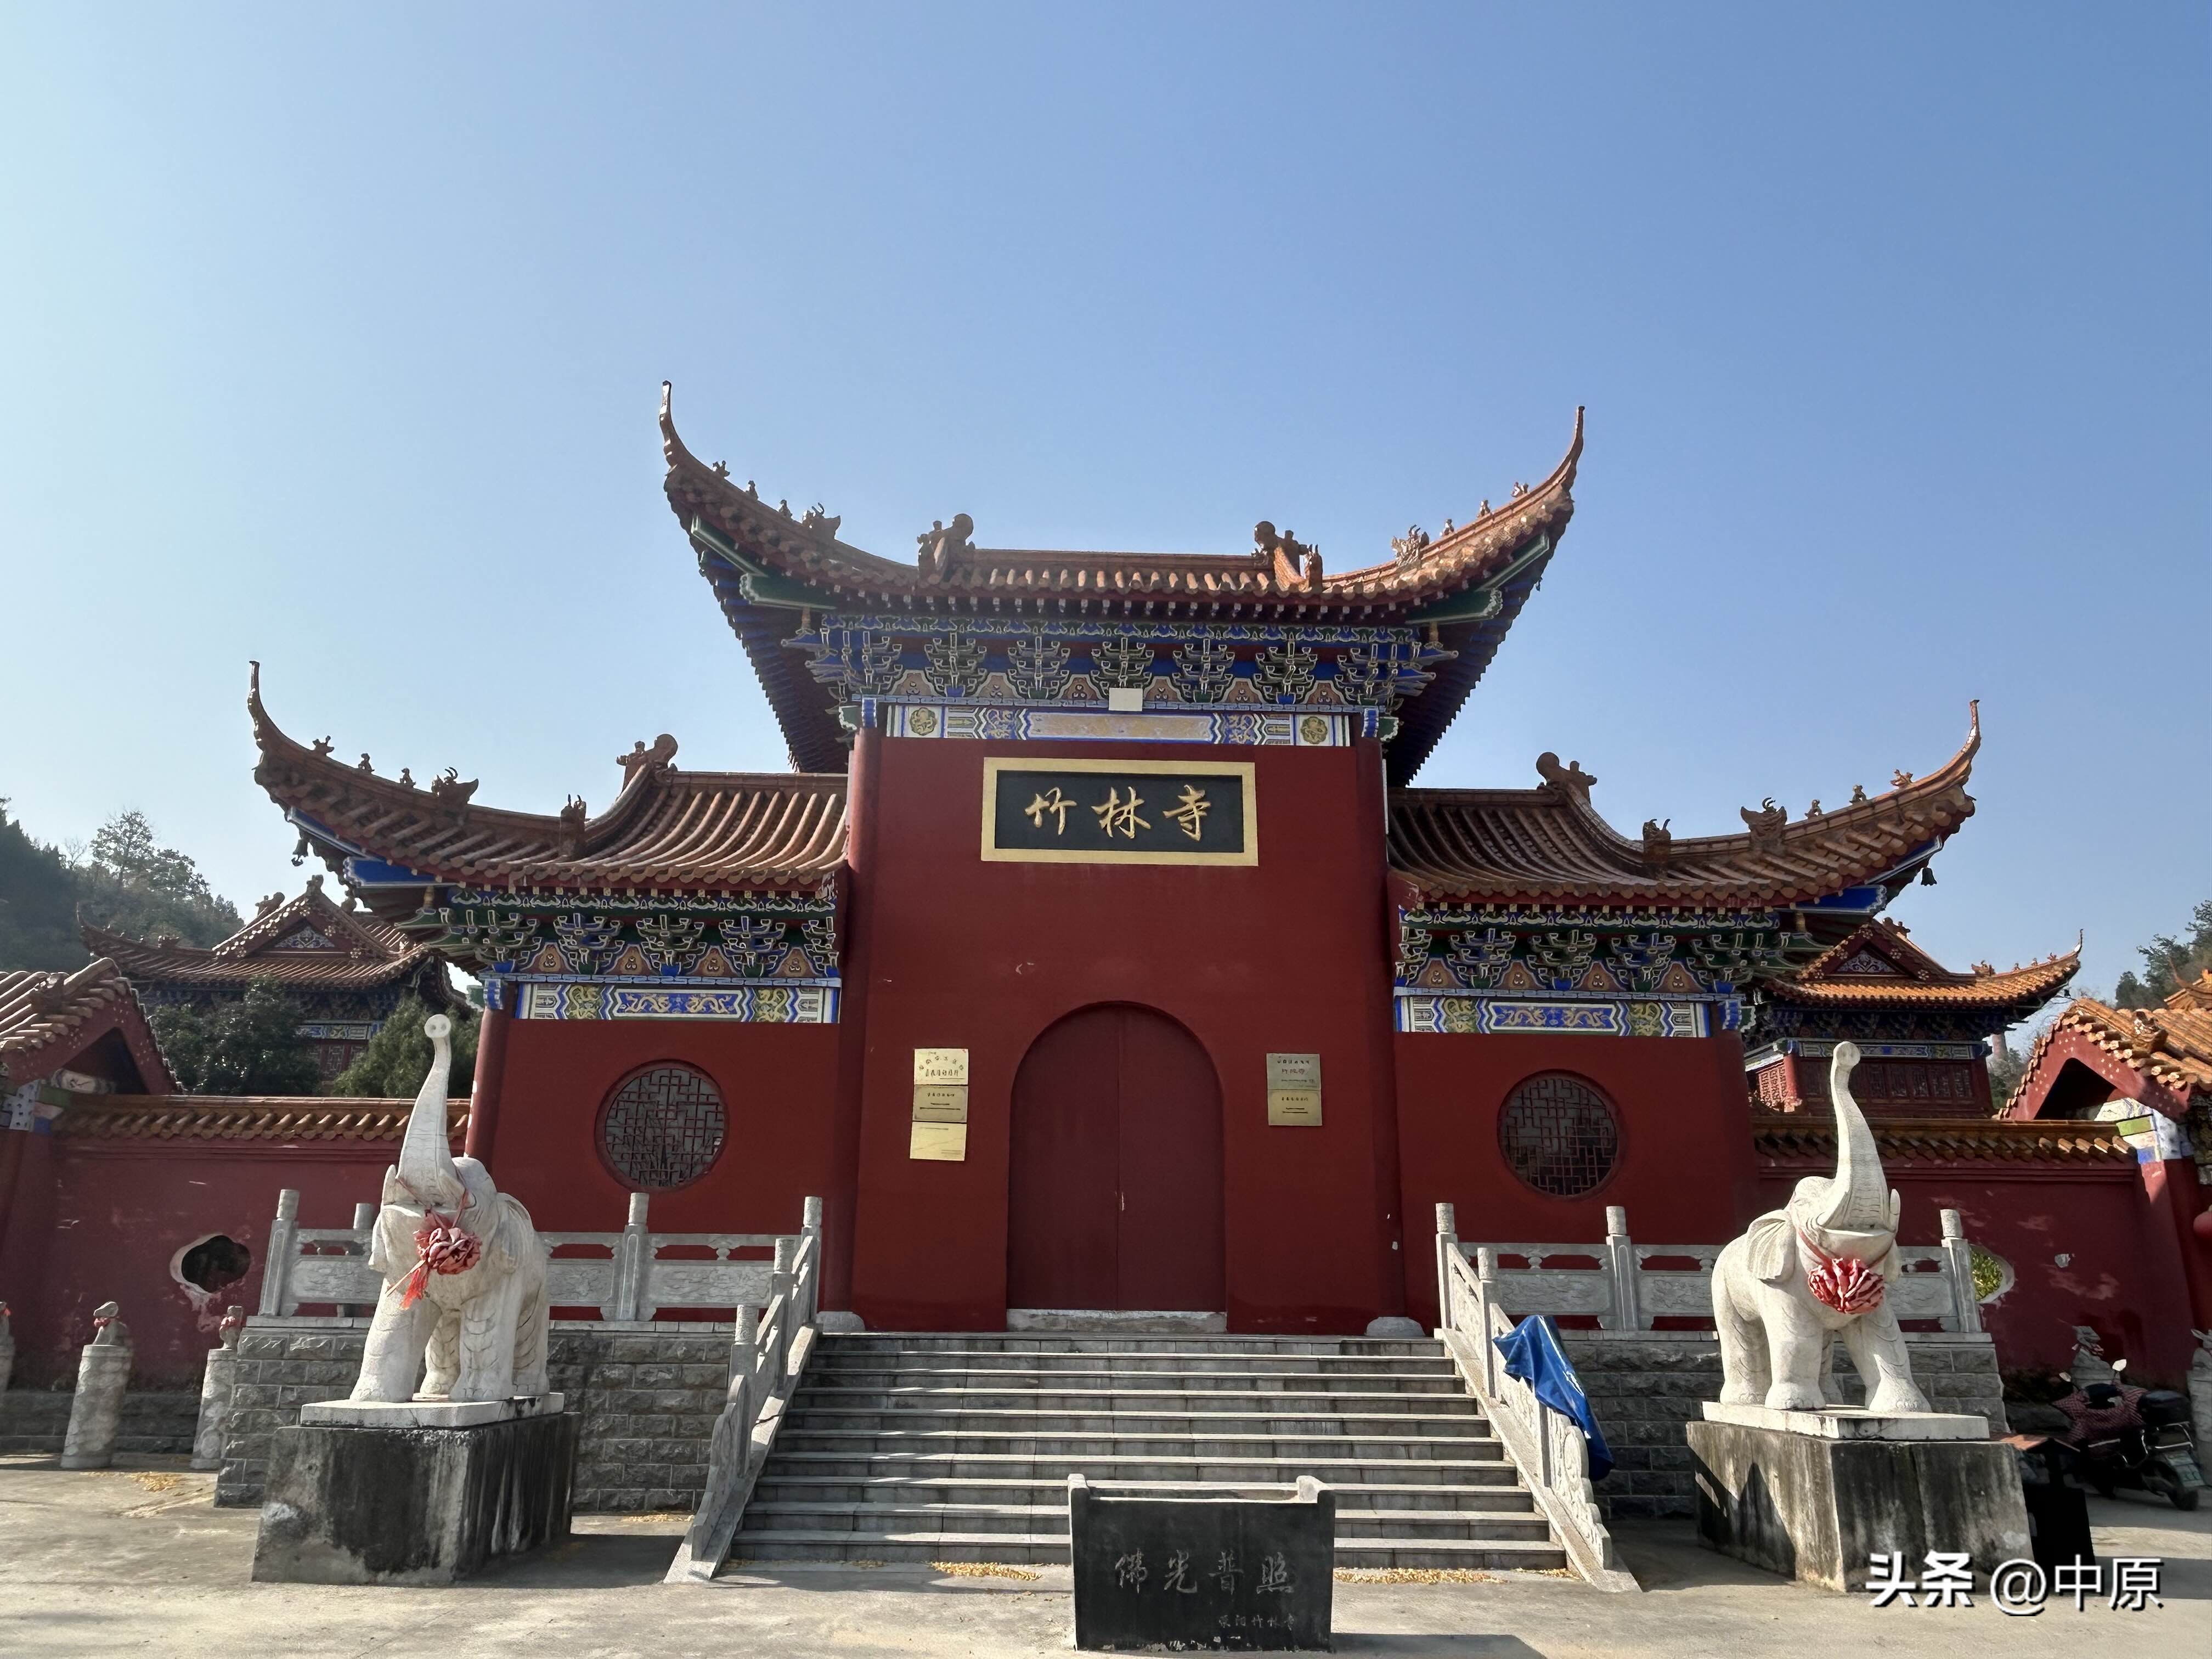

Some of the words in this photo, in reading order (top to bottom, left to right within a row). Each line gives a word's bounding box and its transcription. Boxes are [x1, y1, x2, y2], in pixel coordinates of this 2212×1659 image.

[1024, 784, 1211, 842] 竹林寺
[1114, 1547, 1295, 1595] 佛光普照
